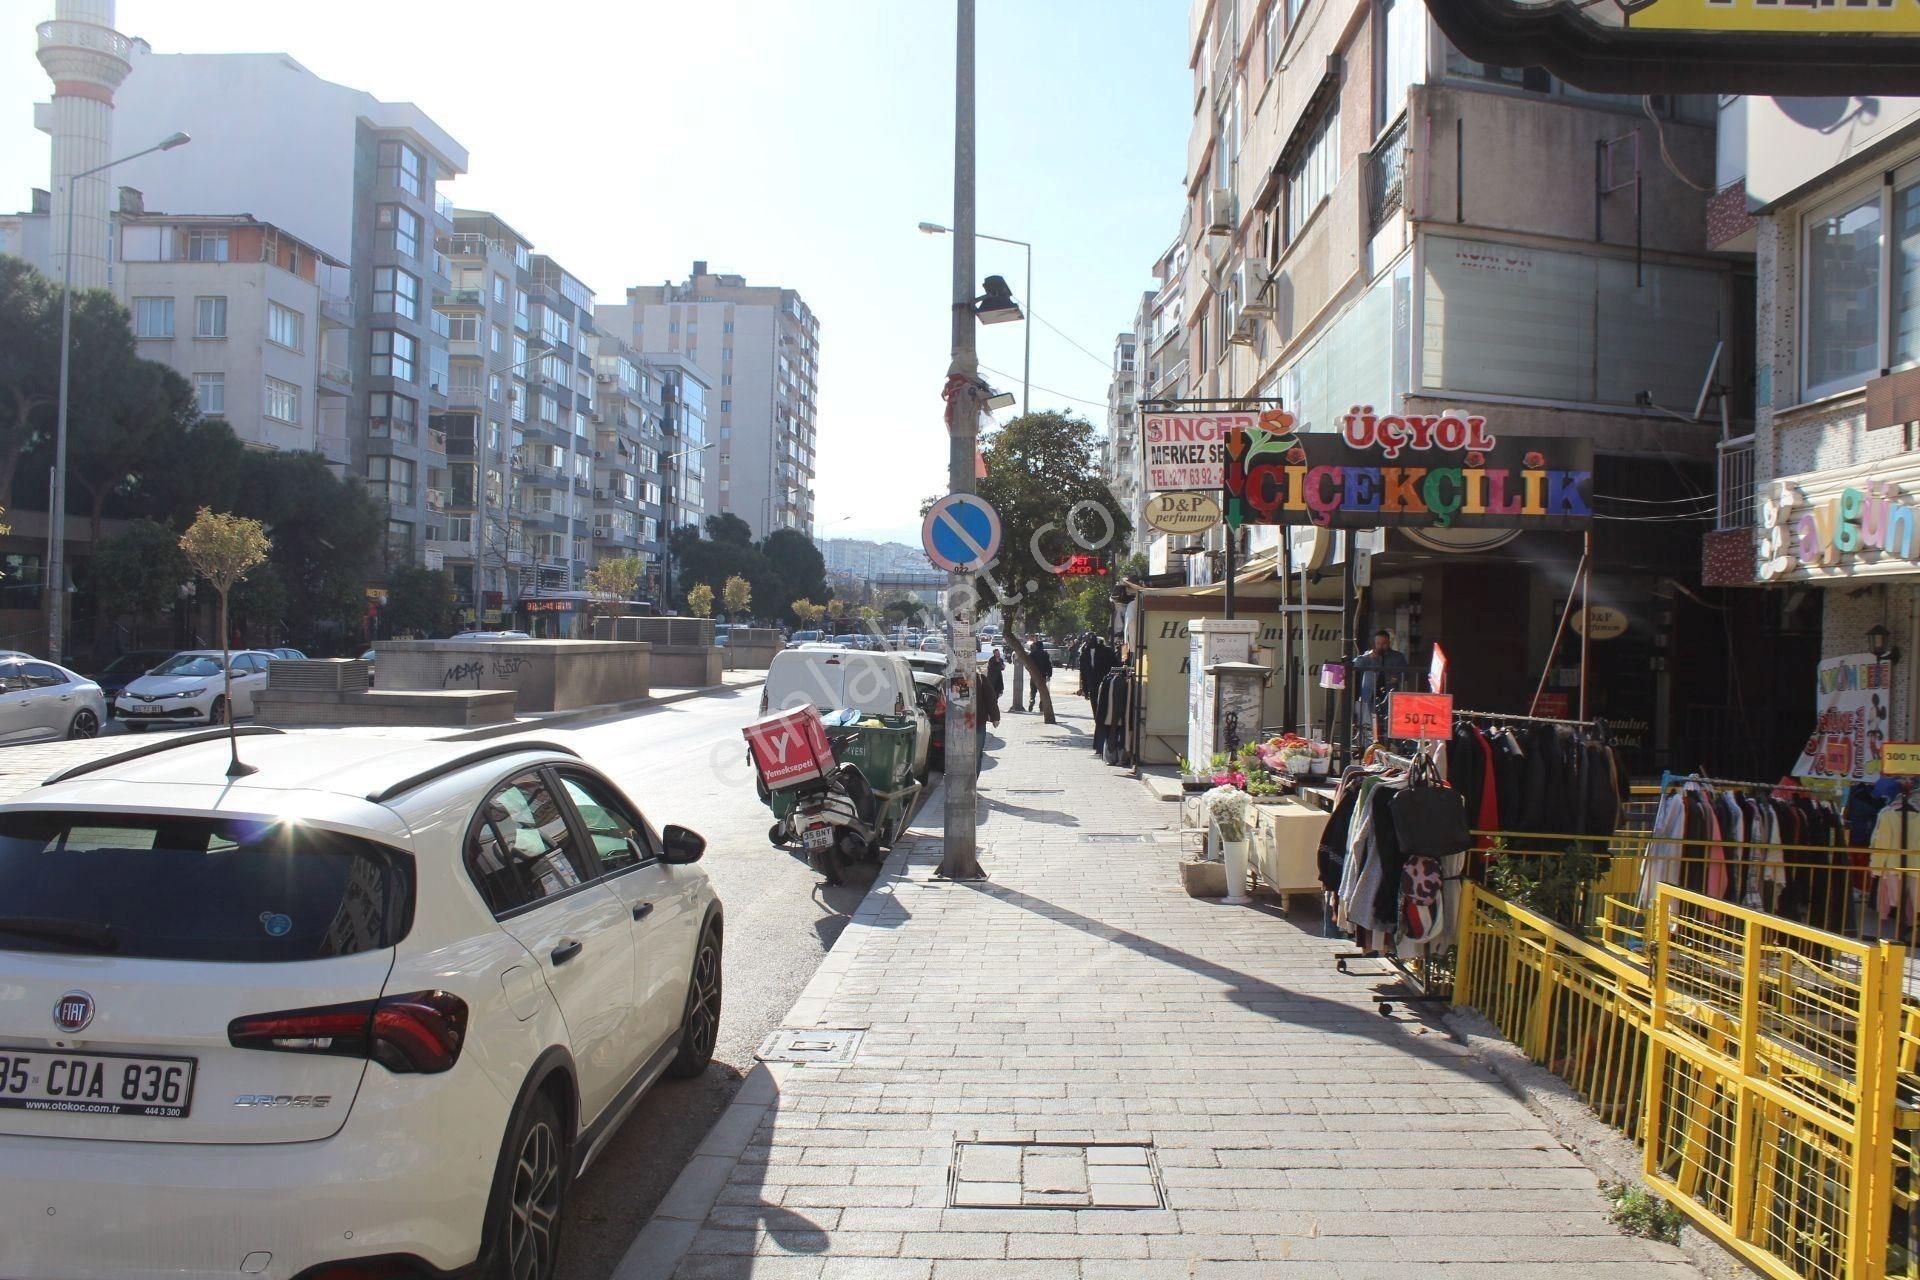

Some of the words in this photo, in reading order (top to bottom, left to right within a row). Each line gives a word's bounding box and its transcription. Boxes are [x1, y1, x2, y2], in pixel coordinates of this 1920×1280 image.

[1344, 405, 1494, 457] ÜÇYOL
[1151, 444, 1205, 465] MERKEZ
[1209, 443, 1224, 464] SE
[1246, 450, 1590, 526] ÇİÇEKÇİLİK
[1404, 712, 1420, 725] 50
[1885, 752, 1906, 761] 300
[764, 758, 814, 781] Yemeksepeti
[62, 1002, 86, 1021] FIAT
[46, 1060, 104, 1099] CDA
[121, 1064, 183, 1104] 836
[26, 1100, 121, 1114] www.otokoc.com.tr
[144, 1107, 159, 1116] 444
[159, 1108, 166, 1116] 3
[166, 1108, 181, 1117] 300
